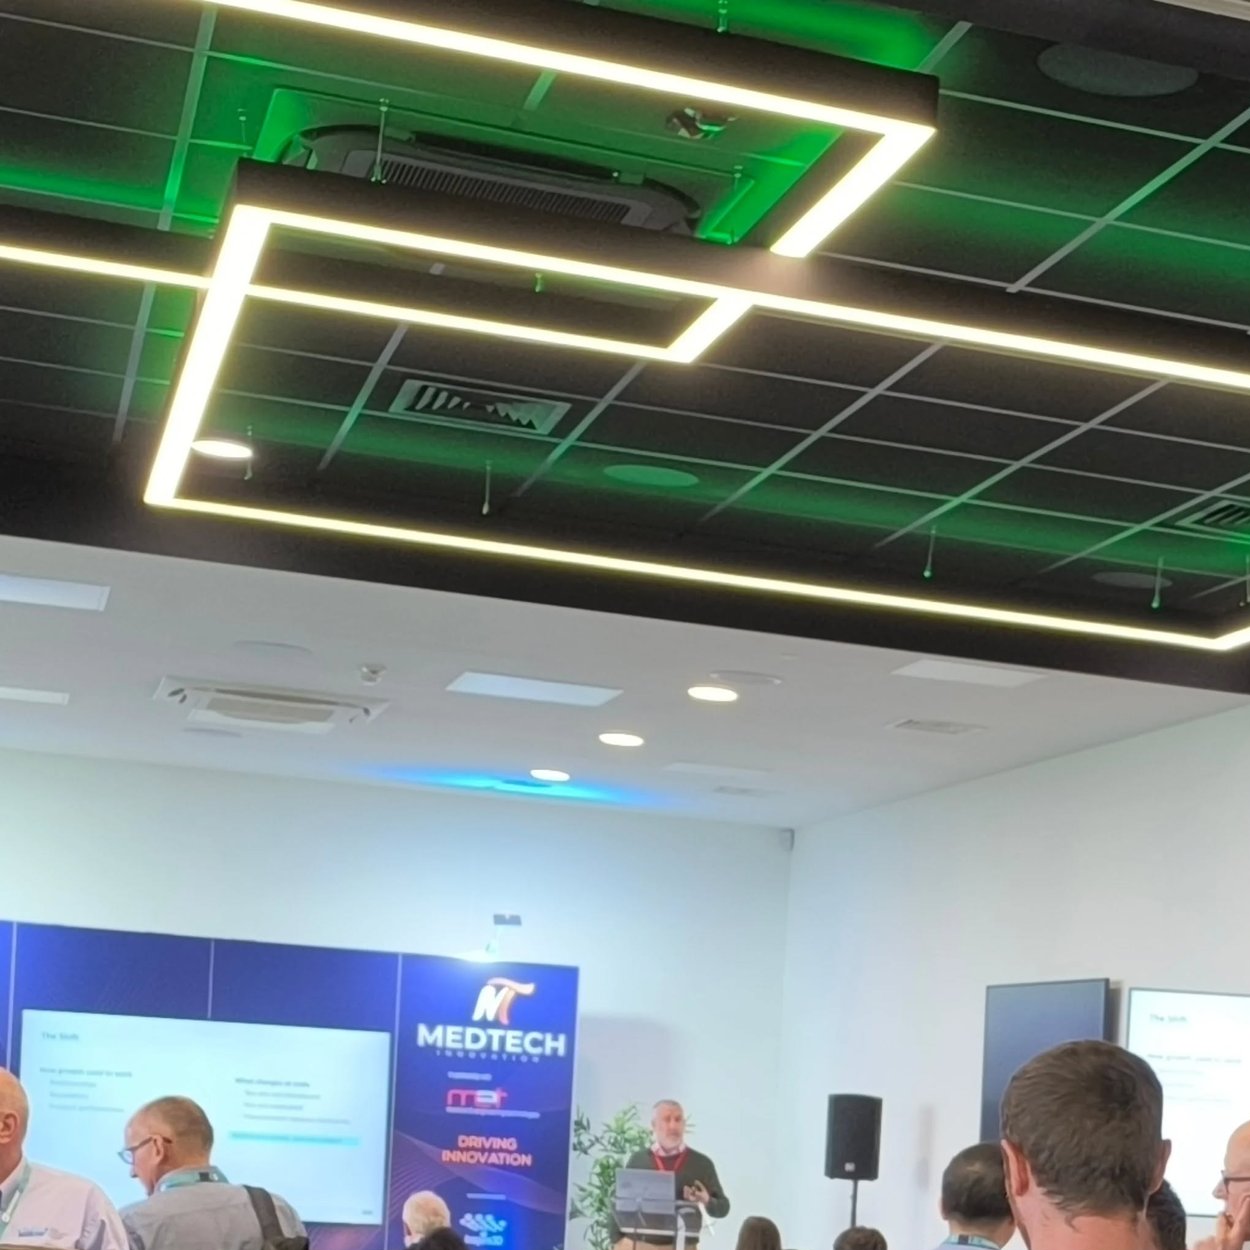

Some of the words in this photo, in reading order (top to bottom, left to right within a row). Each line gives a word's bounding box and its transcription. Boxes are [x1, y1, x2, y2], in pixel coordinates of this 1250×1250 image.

[416, 1022, 567, 1057] MEDTECH
[458, 1134, 518, 1150] DRIVING
[441, 1150, 532, 1167] INNOVATION
